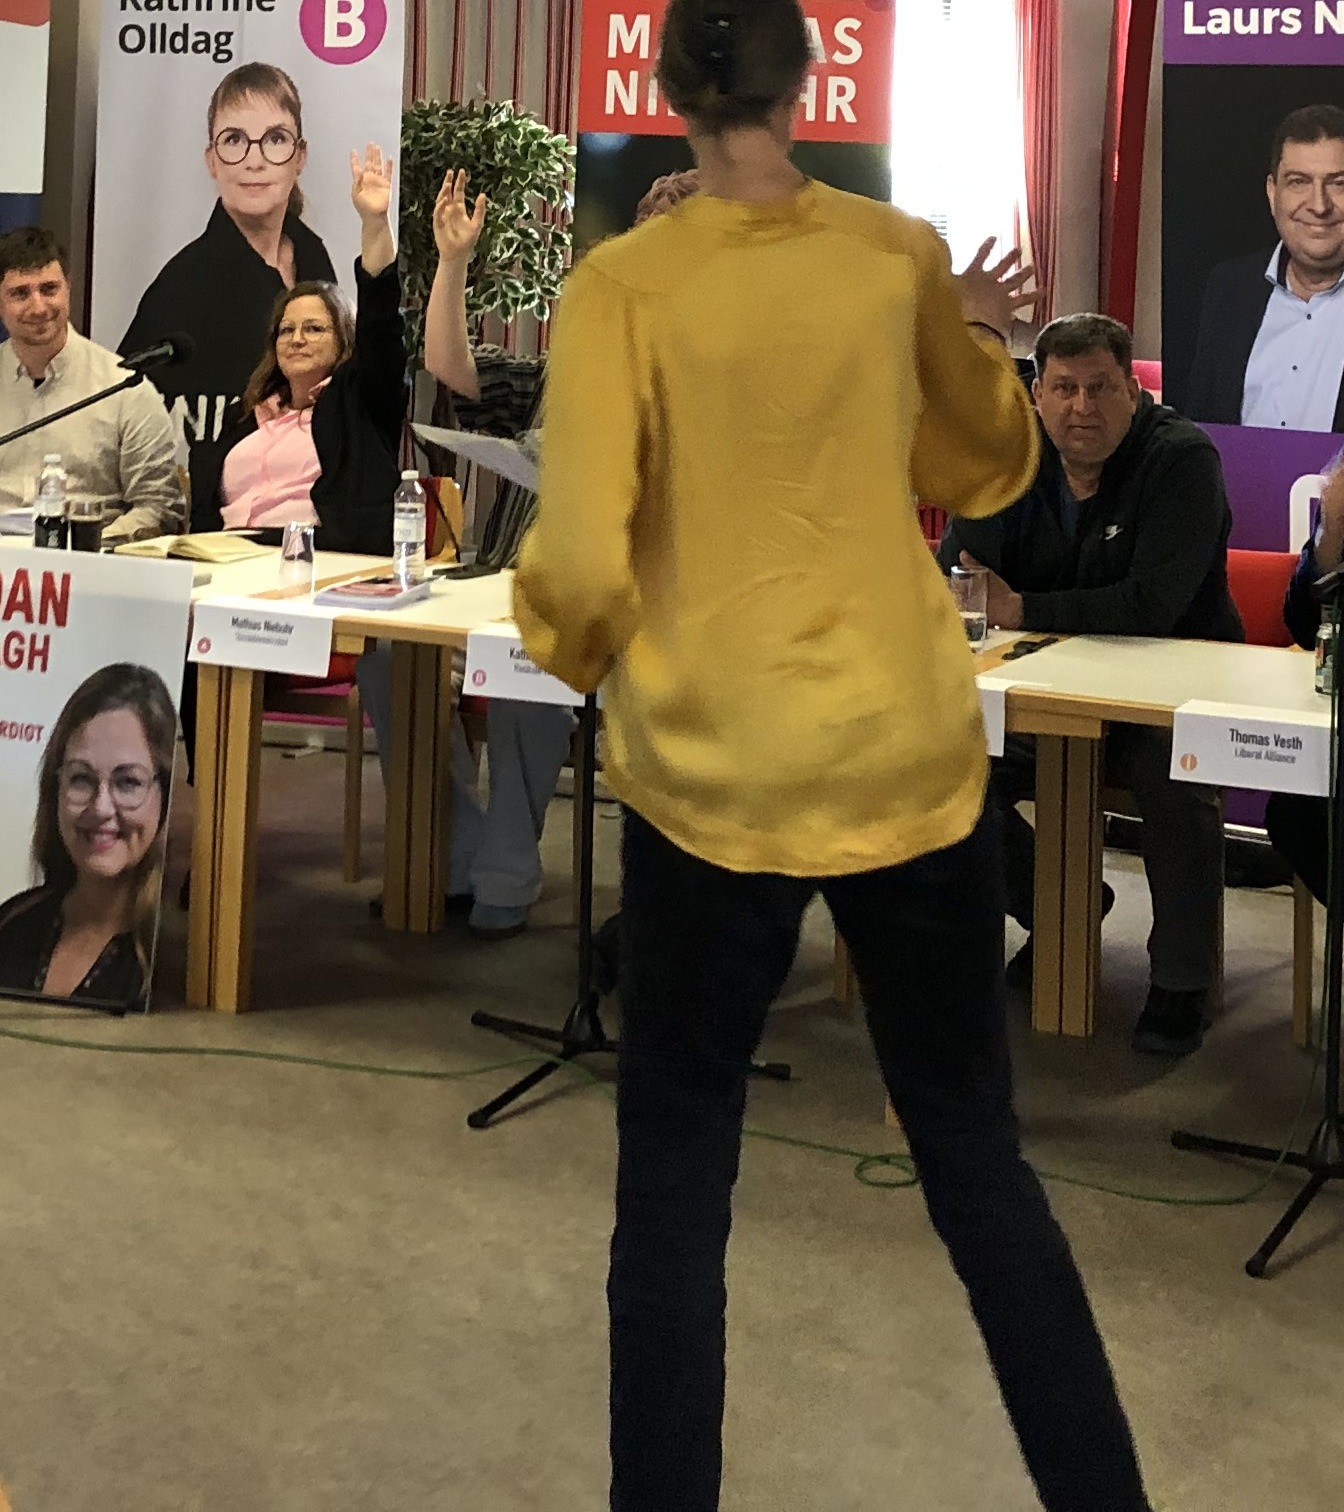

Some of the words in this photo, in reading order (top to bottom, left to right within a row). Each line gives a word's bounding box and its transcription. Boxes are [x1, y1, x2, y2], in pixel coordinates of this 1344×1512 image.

[1183, 0, 1302, 36] Laurs
[118, 23, 234, 63] Olldag
[1229, 728, 1270, 747] Thomas
[1274, 734, 1302, 750] Vesth
